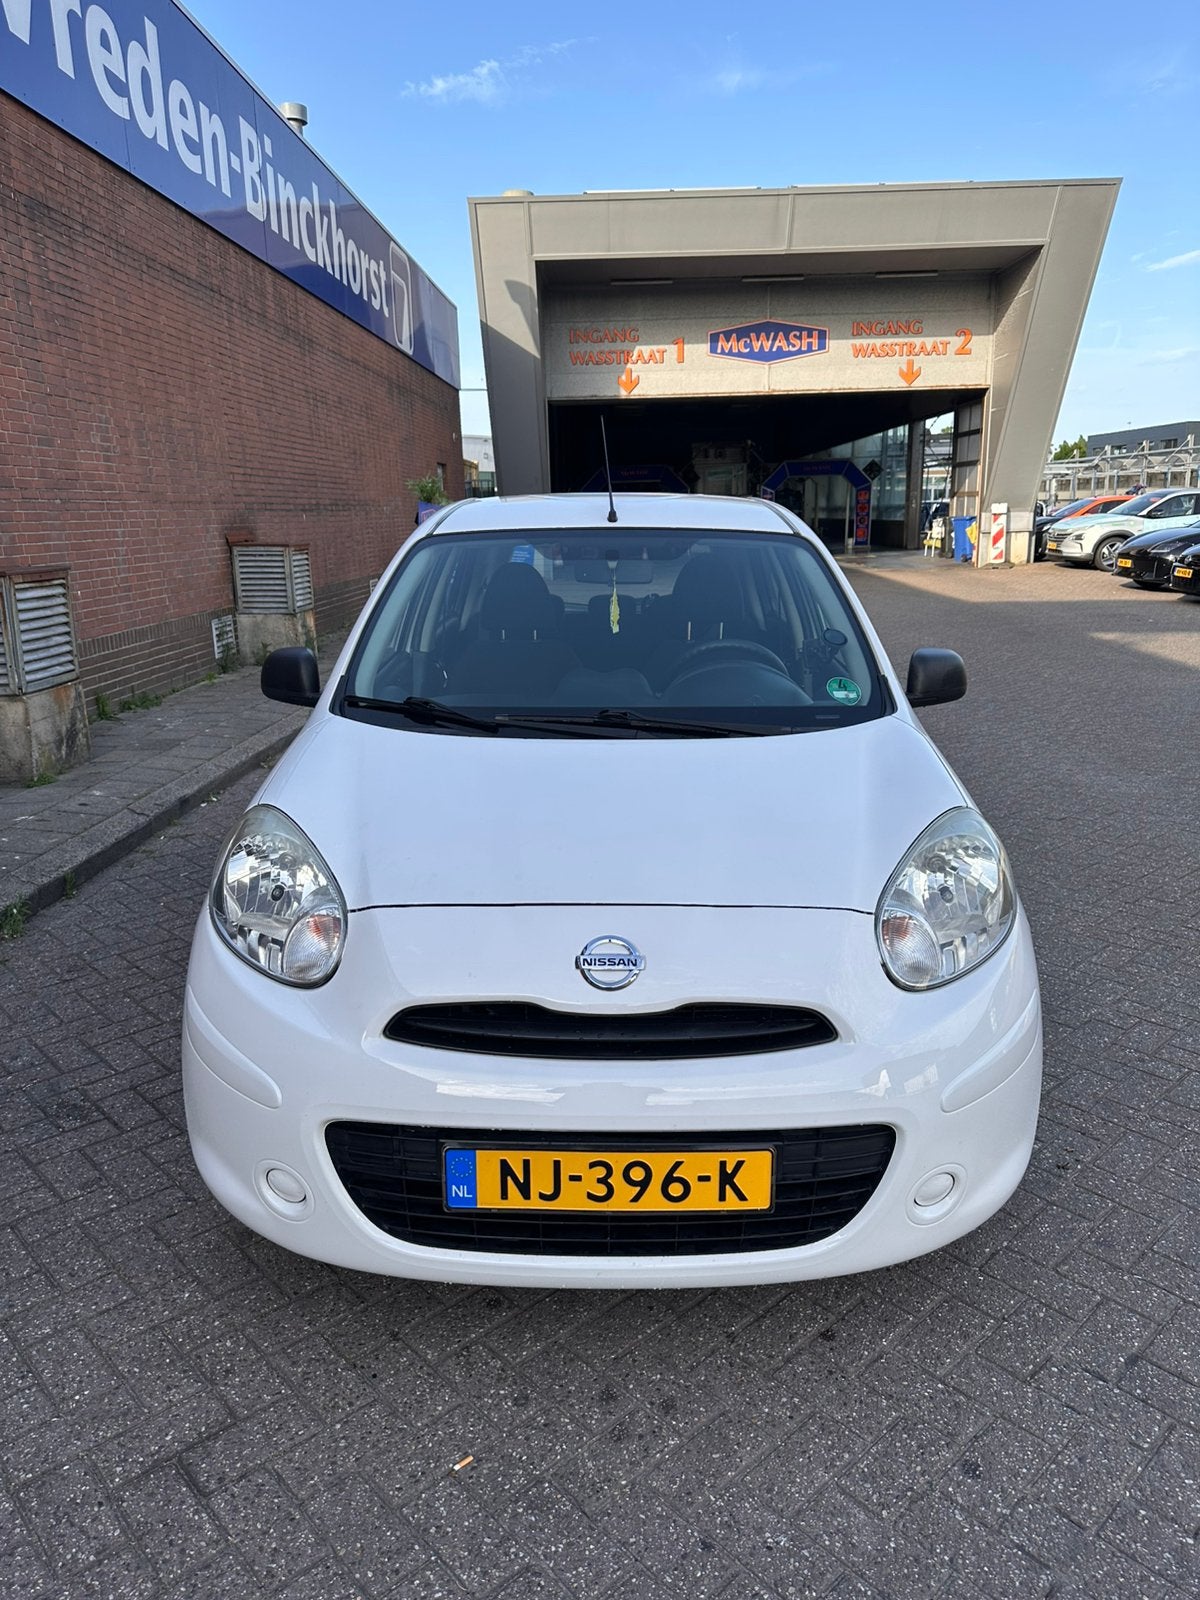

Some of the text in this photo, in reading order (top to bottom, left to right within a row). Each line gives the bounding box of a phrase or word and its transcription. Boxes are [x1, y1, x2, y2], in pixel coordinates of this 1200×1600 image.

[569, 327, 639, 344] INGANG
[850, 320, 923, 336] INGANG
[569, 337, 685, 365] WASSTRAAT 1
[717, 331, 818, 353] McWASH
[851, 328, 973, 358] WASSTRAAT 2
[582, 957, 638, 967] NISSAN
[500, 1158, 749, 1203] NJ-396-K
[452, 1185, 473, 1198] NL
